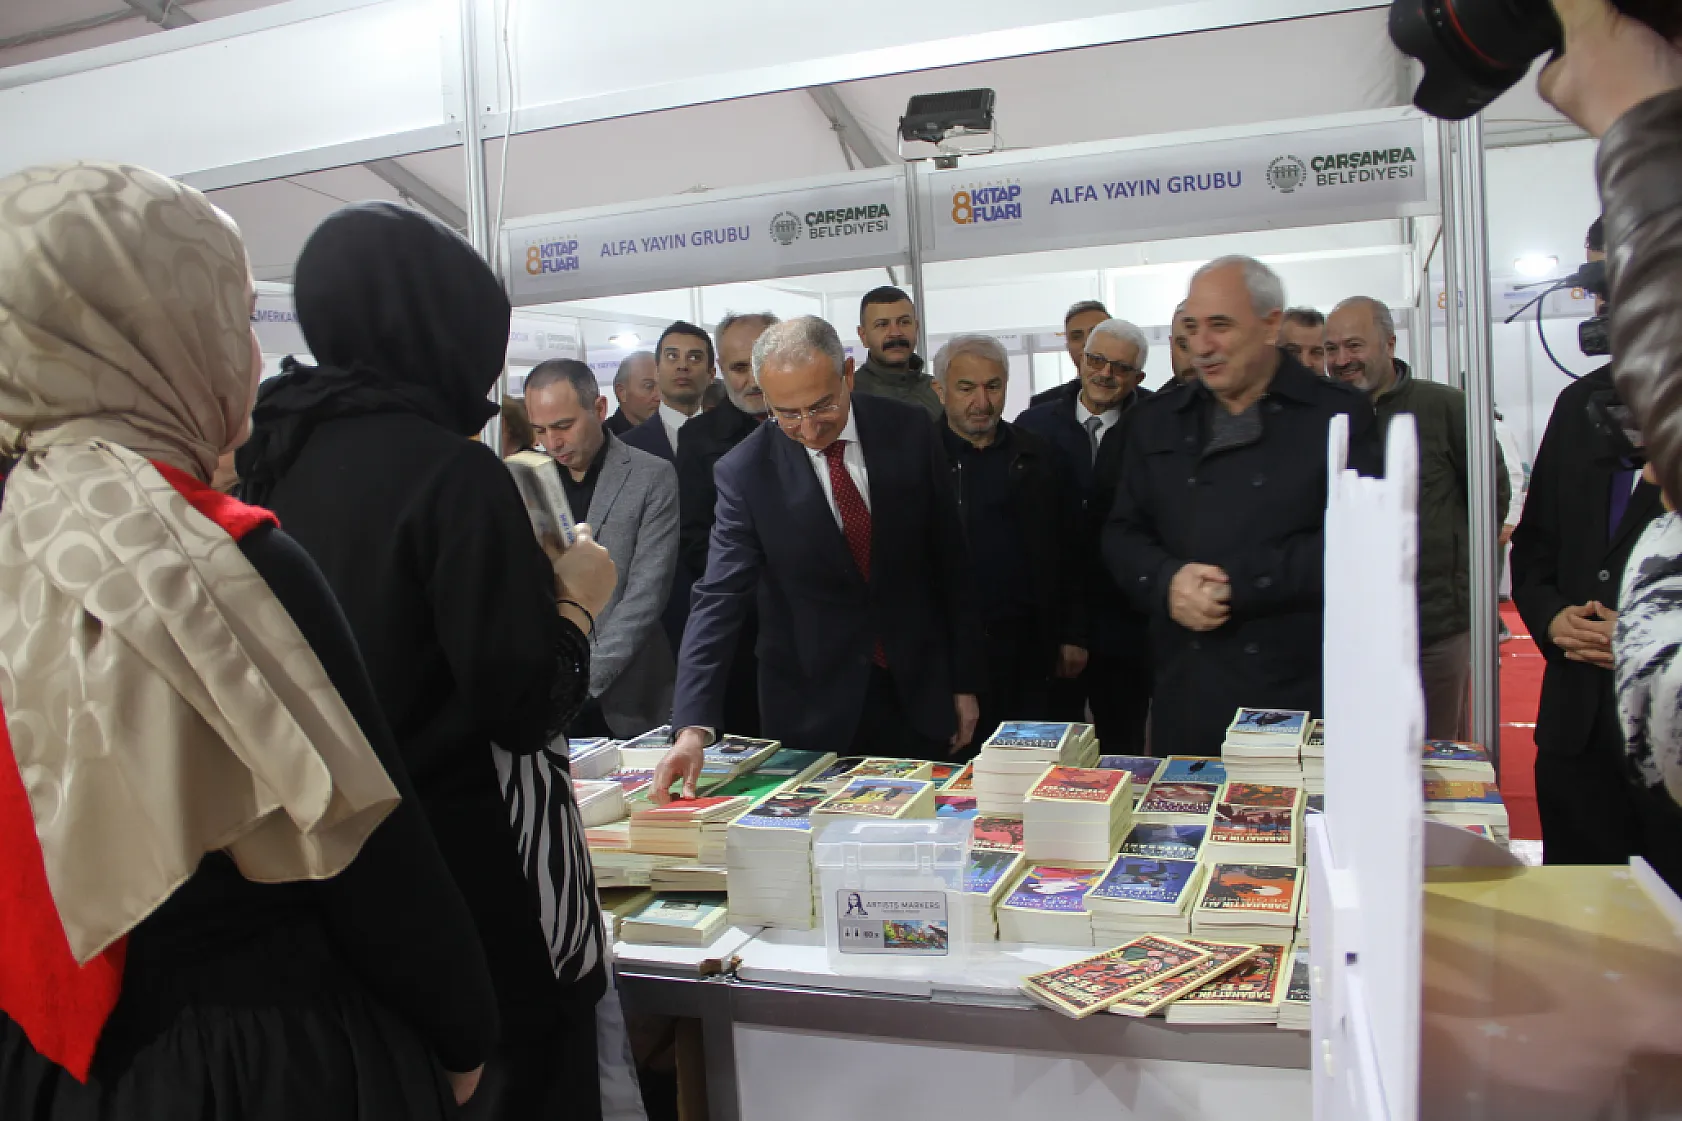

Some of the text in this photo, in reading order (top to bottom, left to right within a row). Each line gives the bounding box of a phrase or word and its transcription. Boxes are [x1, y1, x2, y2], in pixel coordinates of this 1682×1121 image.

[1311, 147, 1416, 172] ÇARŞAMBA
[1317, 165, 1413, 186] BELEDİYESİ
[1050, 184, 1098, 205] ALFA
[1103, 178, 1160, 199] YAYIN
[1166, 170, 1242, 193] GRUBU
[805, 203, 889, 226] ÇARŞAMBA
[972, 202, 1022, 223] FUARI
[600, 239, 638, 257] ALFA
[641, 233, 686, 252] YAYIN
[691, 225, 750, 246] GRUBU
[866, 901, 941, 910] ARTISTS MARKERS
